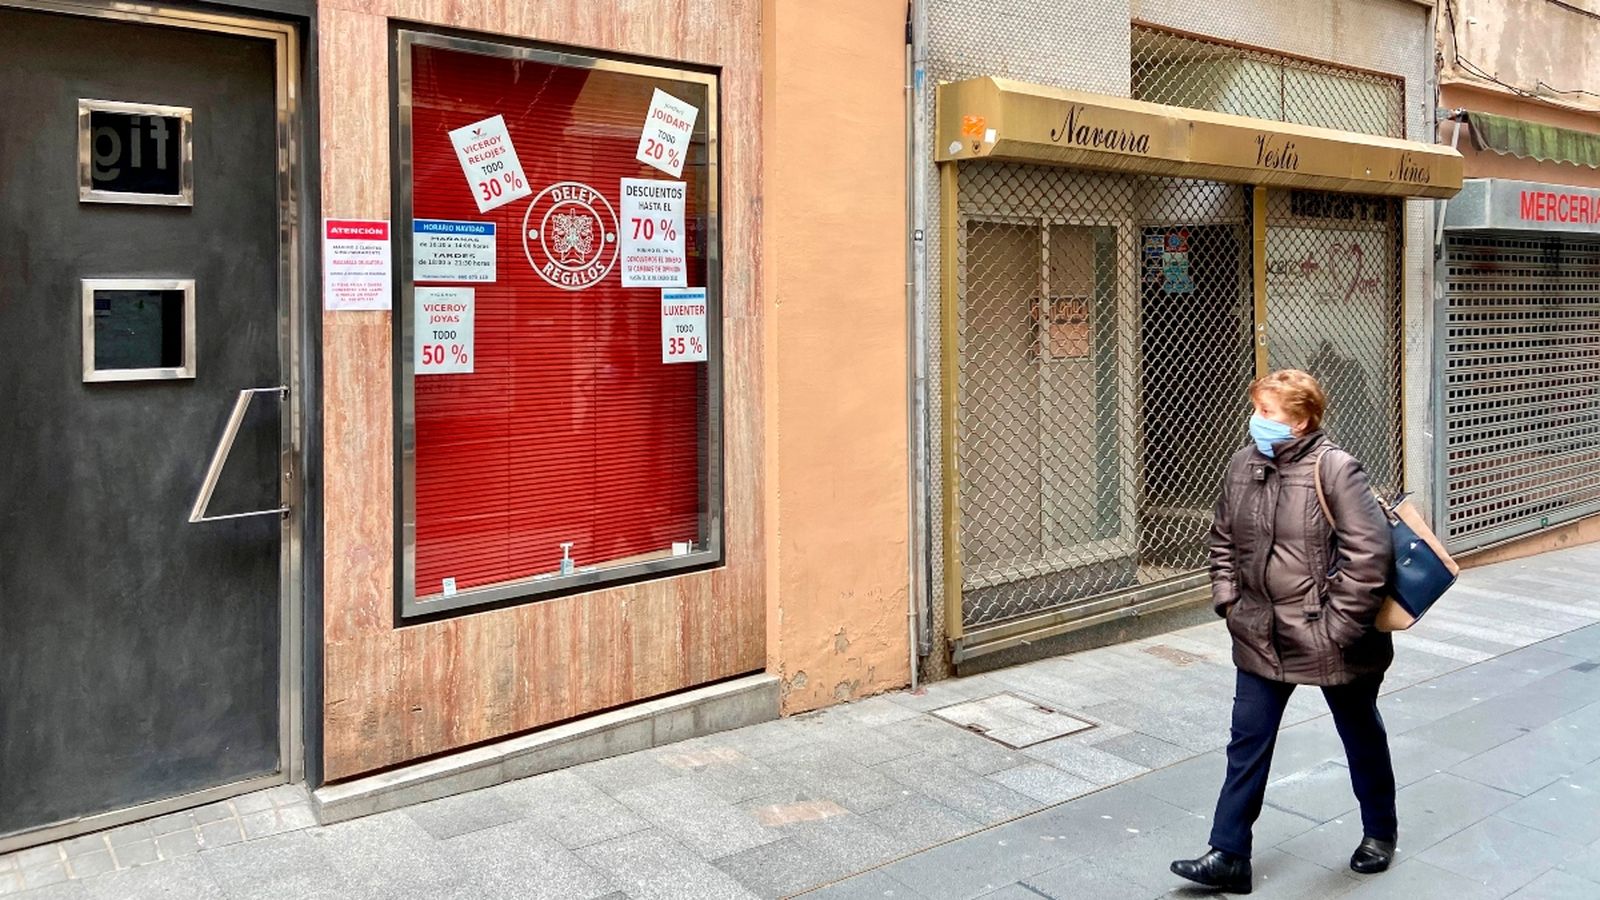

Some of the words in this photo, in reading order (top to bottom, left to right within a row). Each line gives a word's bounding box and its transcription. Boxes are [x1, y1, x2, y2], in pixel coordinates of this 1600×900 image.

[651, 108, 691, 133] JOIDART
[462, 135, 503, 154] VICEROY
[658, 129, 676, 145] TODO
[1050, 104, 1151, 154] Navarra
[1255, 134, 1300, 171] Vestir
[1389, 152, 1432, 184] Niños
[468, 146, 506, 165] RELOJES
[644, 139, 664, 160] 20
[667, 148, 680, 168] %
[481, 160, 504, 176] TODO
[479, 178, 502, 201] 30
[504, 171, 522, 191] %
[626, 185, 683, 200] DESCUENTOS
[551, 186, 598, 205] DELEY
[638, 202, 662, 211] HASTA
[663, 202, 672, 211] EL
[330, 226, 384, 235] ATENCIÓN
[423, 224, 455, 233] HORARIO
[455, 224, 485, 233] NAVIDAD
[631, 218, 654, 241] 70
[660, 218, 676, 241] %
[542, 260, 606, 285] REGALOS
[423, 303, 468, 312] VICEROY
[664, 305, 705, 316] LUXENTER
[429, 315, 460, 325] JOYAS
[432, 330, 457, 340] TODO
[676, 325, 694, 333] TODO
[669, 337, 686, 355] 35
[690, 336, 703, 353] %
[422, 344, 445, 365] 50
[451, 344, 468, 365] %
